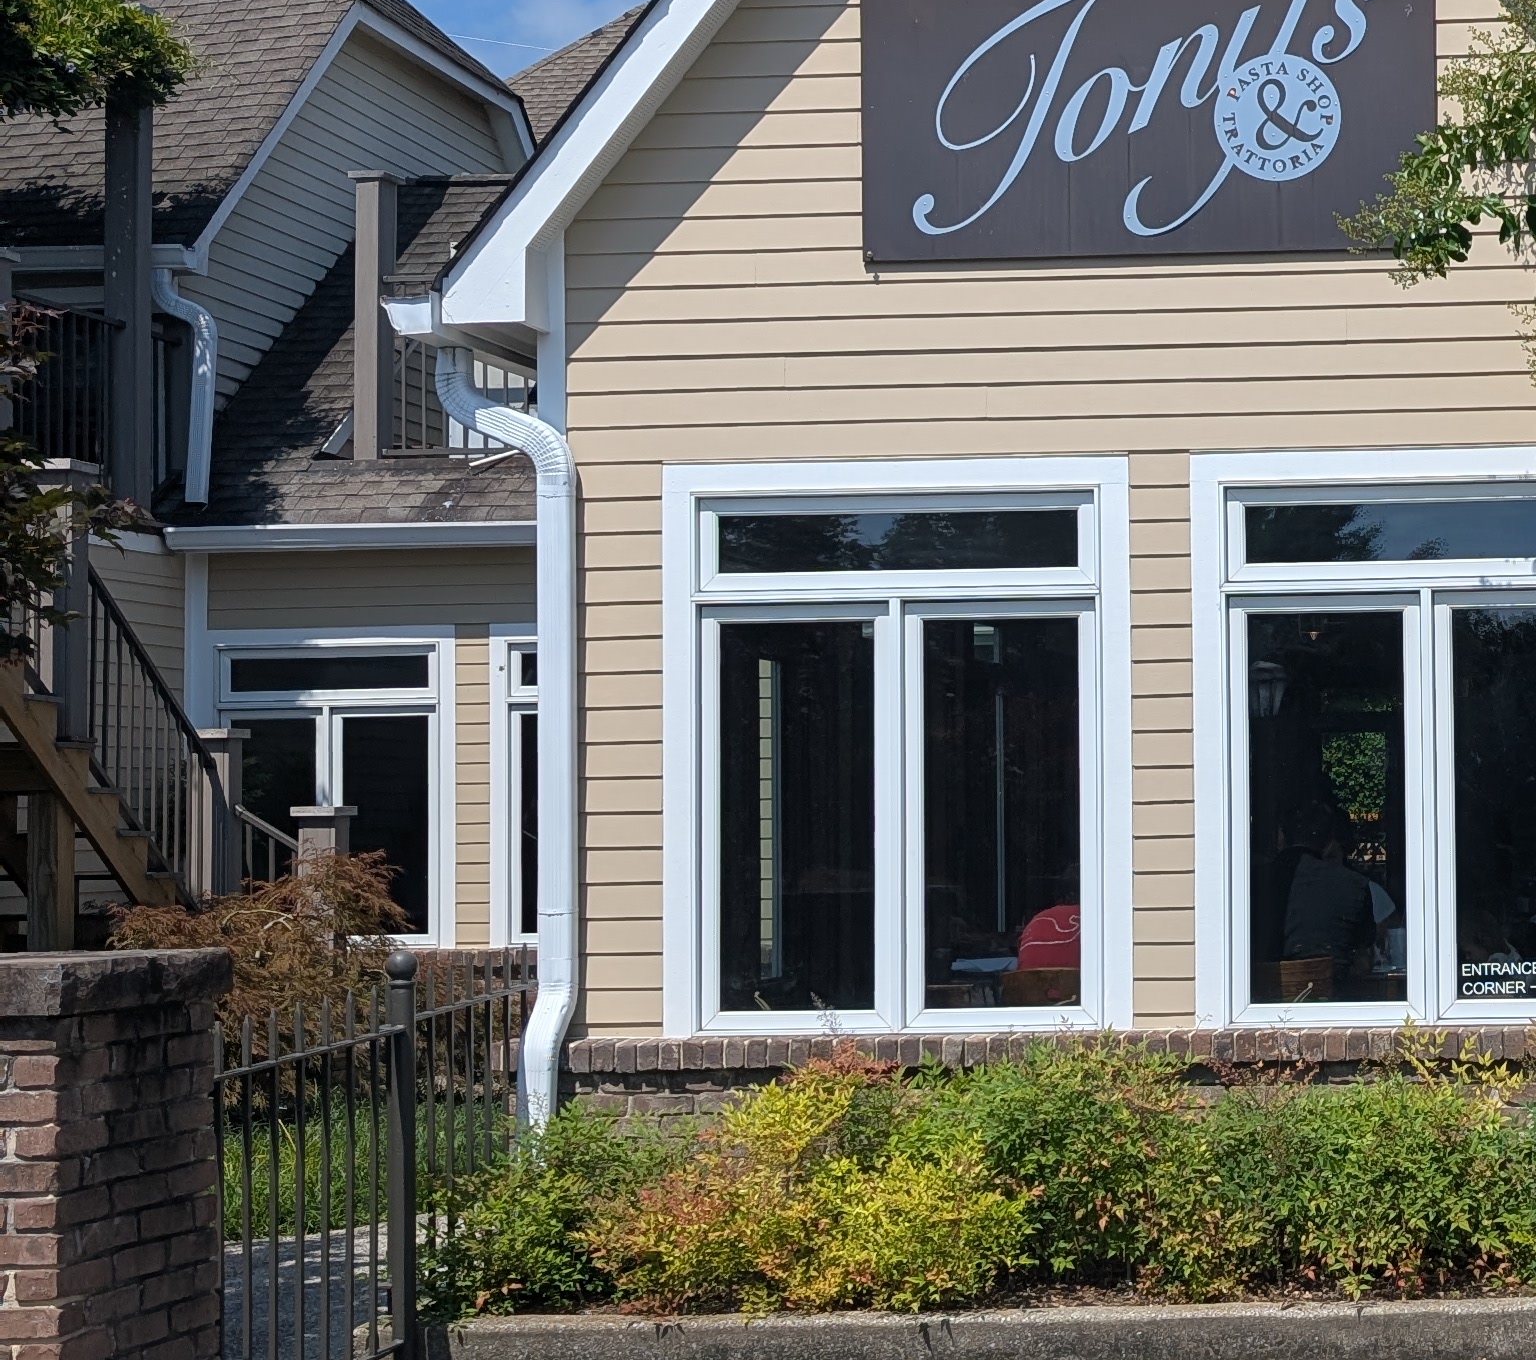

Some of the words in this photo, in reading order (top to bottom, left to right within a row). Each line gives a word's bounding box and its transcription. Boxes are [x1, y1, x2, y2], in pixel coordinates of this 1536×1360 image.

[1226, 61, 1290, 103] PASTA
[1296, 68, 1334, 126] SHOP
[1255, 78, 1324, 151] &
[1222, 112, 1325, 173] TRATTORIA
[1462, 980, 1527, 996] CORNER
